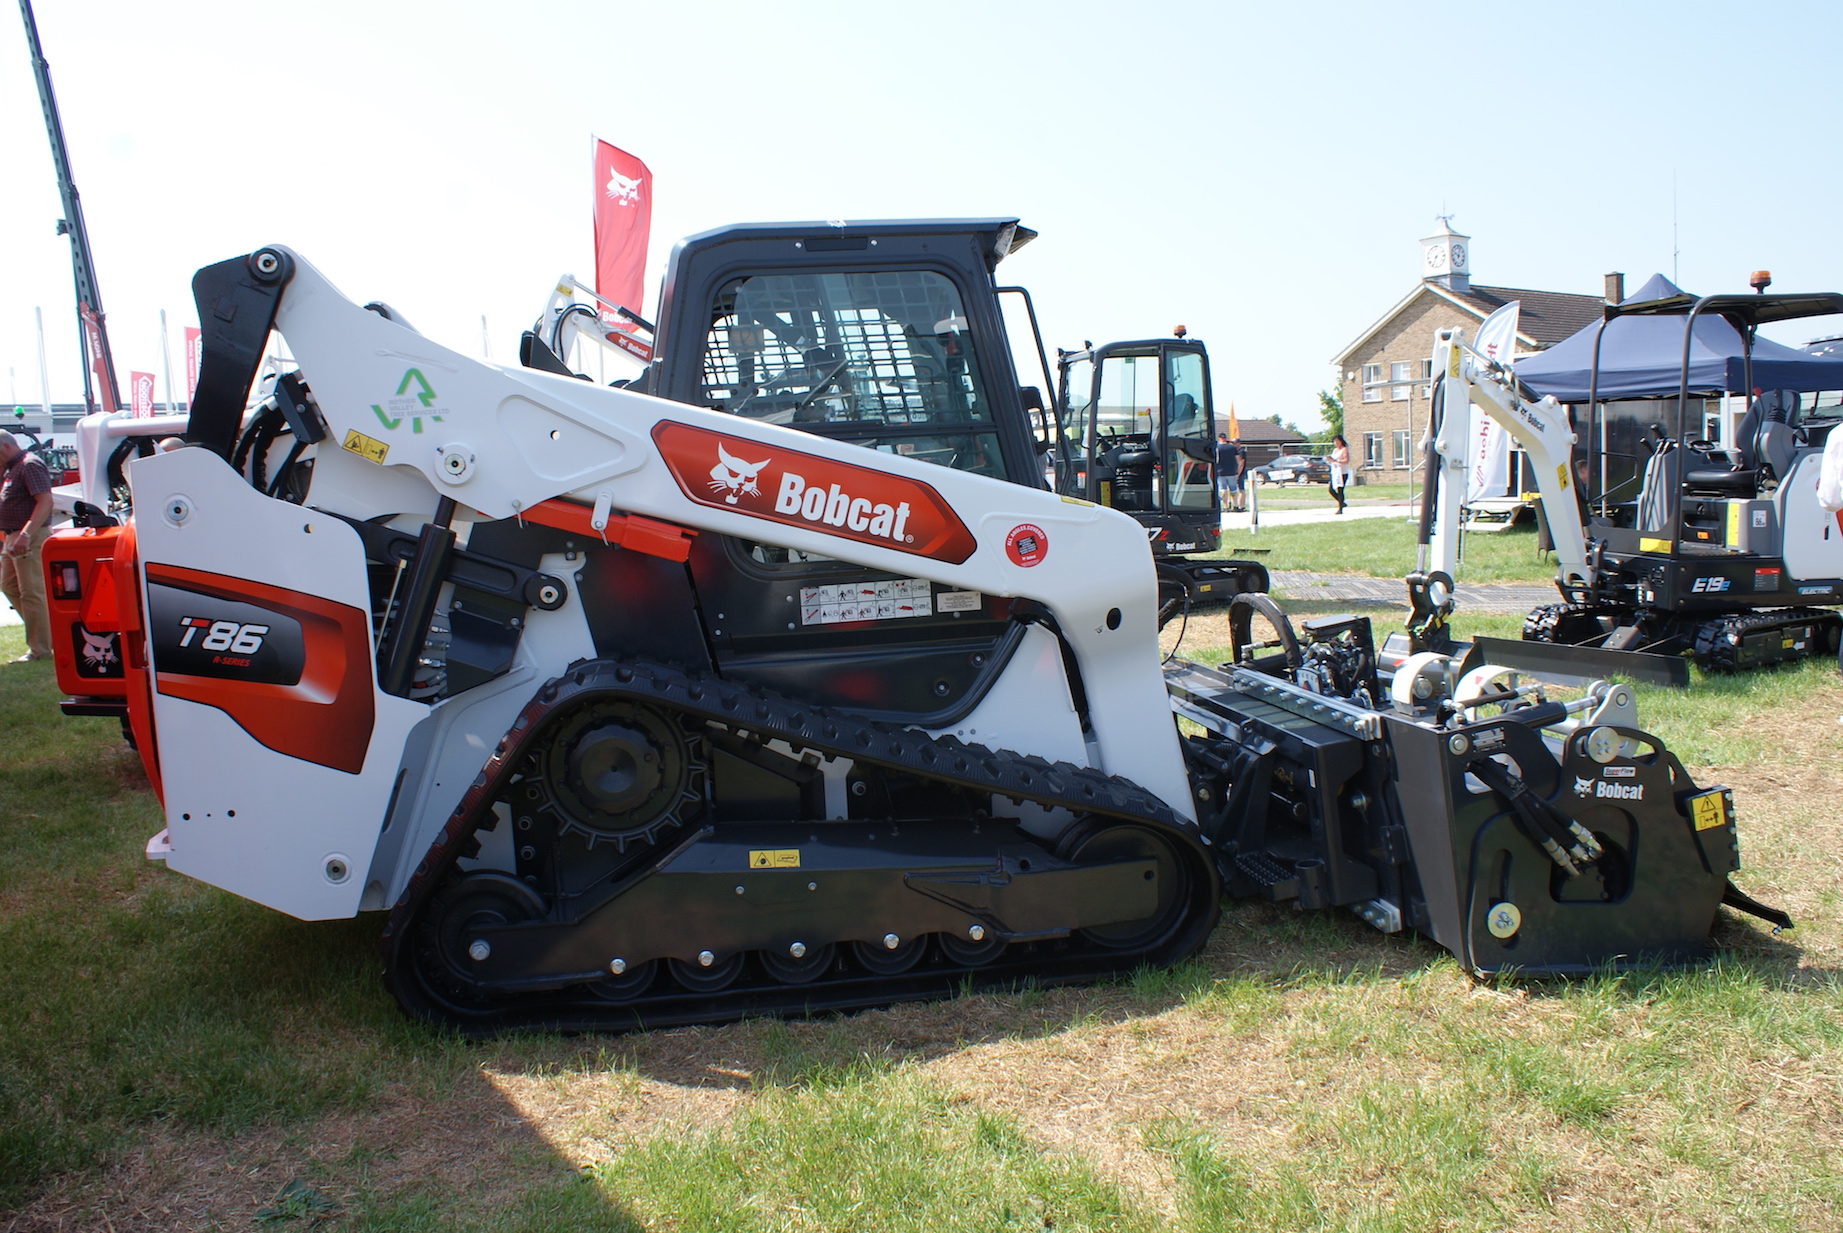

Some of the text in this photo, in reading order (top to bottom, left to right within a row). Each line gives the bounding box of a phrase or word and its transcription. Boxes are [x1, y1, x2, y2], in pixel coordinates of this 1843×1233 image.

[1527, 413, 1545, 433] Bobcat
[775, 472, 911, 542] Bobcat
[1175, 542, 1196, 550] Bobcat
[1691, 577, 1731, 593] E19e
[180, 616, 269, 654] T86
[213, 656, 250, 667] R-SERIES
[1596, 781, 1643, 800] Bobcat
